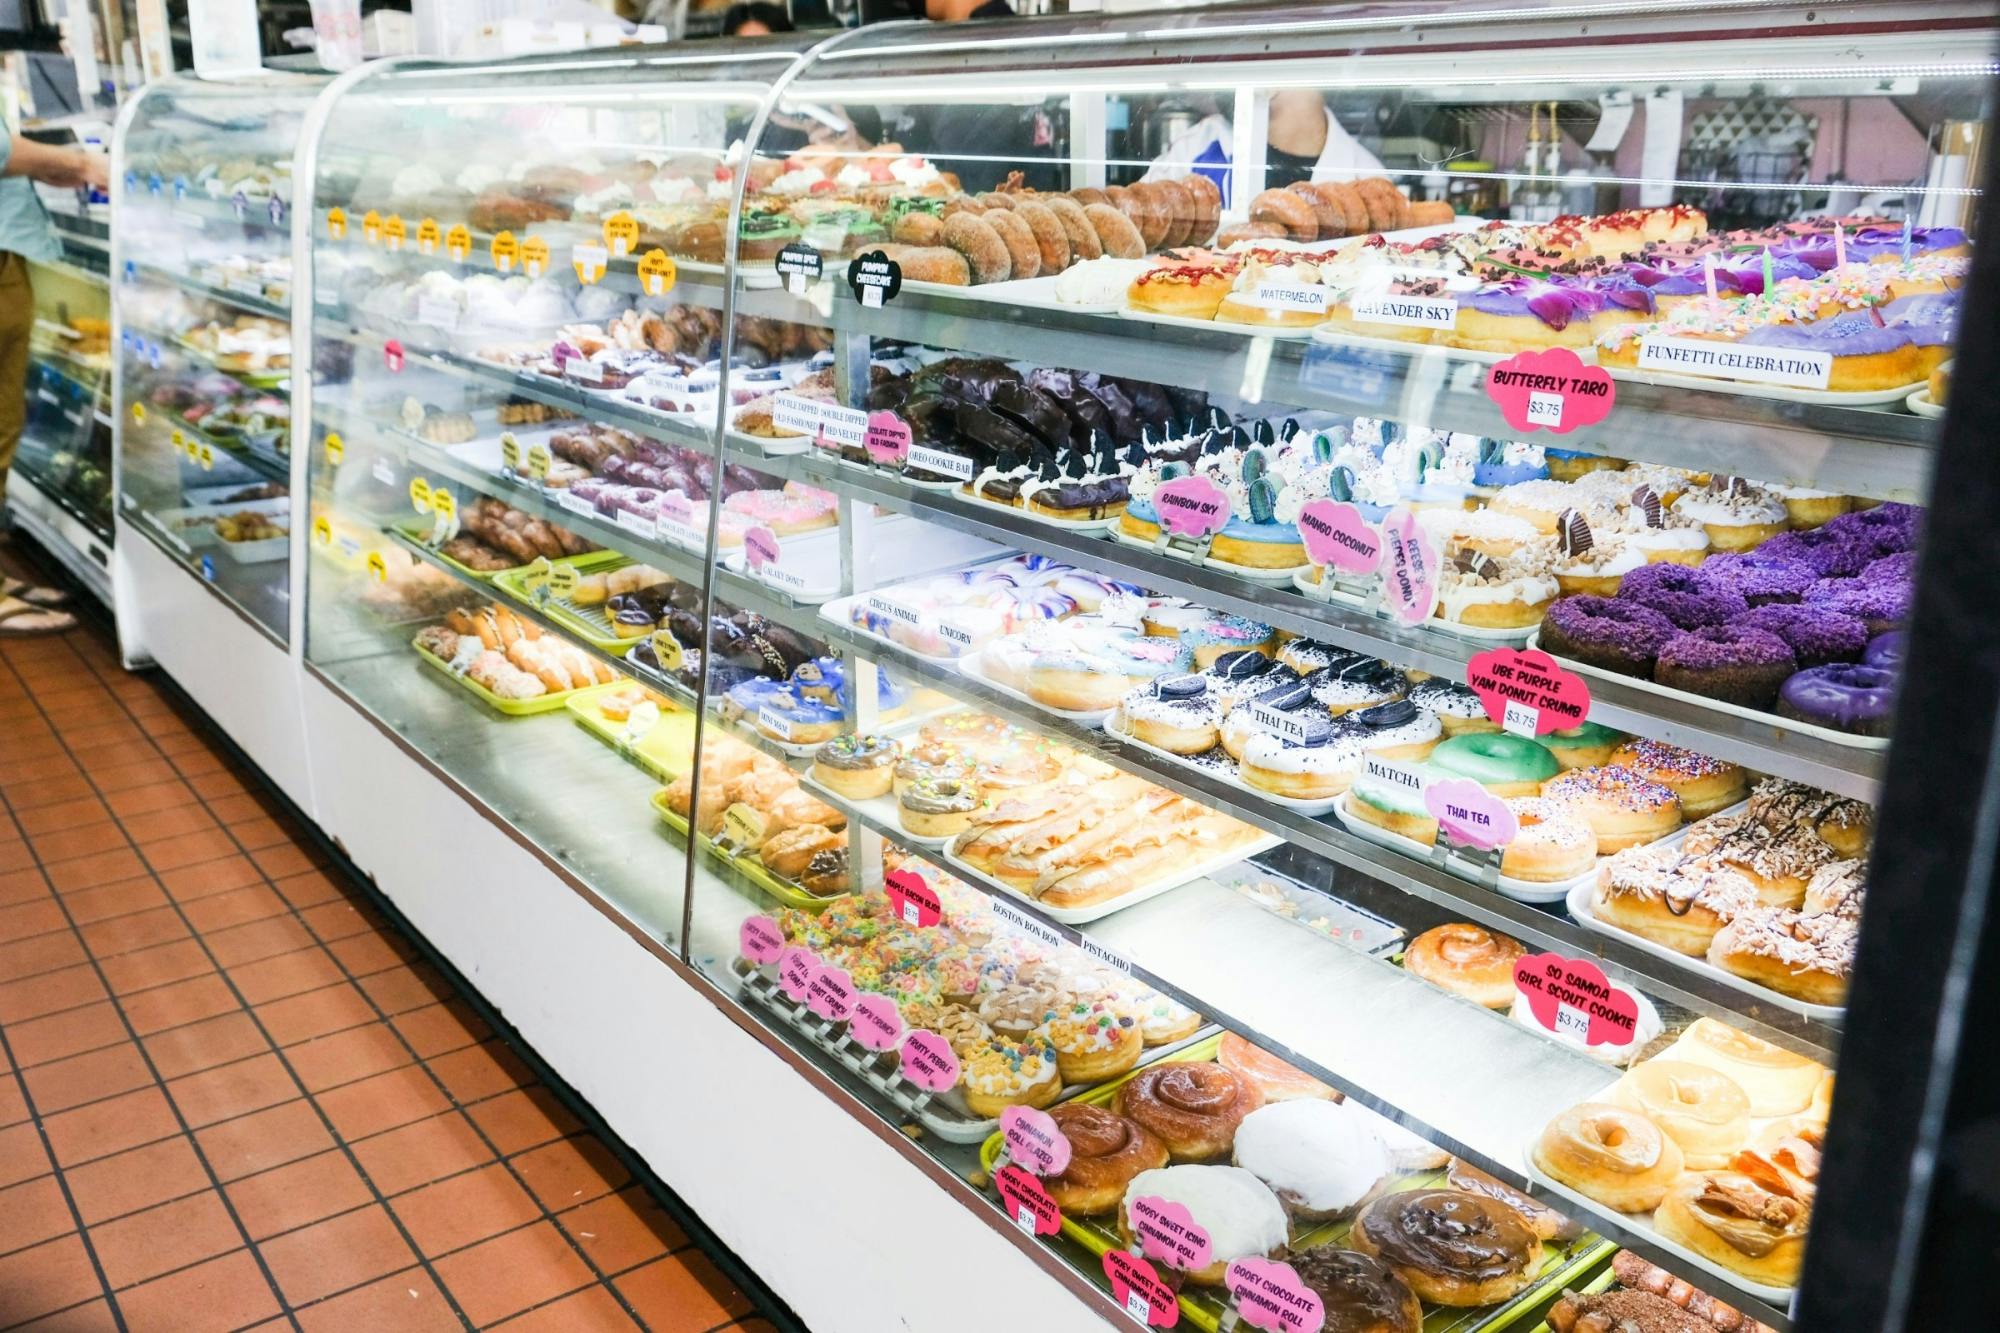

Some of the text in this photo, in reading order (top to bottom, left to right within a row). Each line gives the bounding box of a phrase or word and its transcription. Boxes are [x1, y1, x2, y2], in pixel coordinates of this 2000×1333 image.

[856, 261, 892, 286] PUMPKIN CHEESECAKE
[1260, 289, 1324, 304] WATERMELON
[1358, 301, 1454, 321] LAVENDER SKY
[1646, 346, 1823, 377] FUNFETTI CELEBRATION
[1494, 370, 1608, 397] BUTTERFLY TARO
[777, 398, 819, 415] DOUBLE DIPPED
[820, 408, 866, 426] DOUBLE DIPPED
[1528, 400, 1560, 417] $3.75
[787, 416, 818, 431] FASHIONED
[909, 450, 970, 474] OREO COOKIE BAR
[1161, 493, 1218, 516] RAINBOW SKY
[1302, 512, 1376, 558] MANGO COCONUT
[1388, 528, 1416, 610] PIECES DONUT
[869, 598, 919, 624] CIRCUS ANIMAL
[939, 625, 972, 645] UNICORN
[1492, 662, 1562, 693] UBE PURPLE
[1472, 674, 1582, 718] YAM DONUT CRUMB
[1254, 709, 1304, 738] THAI TEA
[1506, 709, 1535, 728] $3.75
[1368, 761, 1420, 790] MATCHA
[1446, 805, 1490, 827] THAI TEA
[886, 878, 904, 894] MAPLE
[905, 888, 924, 904] BACON
[993, 902, 1060, 947] BOSTON BON BON
[1083, 940, 1129, 972] PISTACHIO
[788, 970, 805, 989] DONUT
[820, 975, 848, 999] CINNAMON
[1545, 964, 1610, 1001] SO SAMOA
[809, 982, 848, 1015] TOAST CRUNCH
[1518, 970, 1636, 1030] GIRL SCOUT COOKIE
[872, 1016, 896, 1036] CRUNCH
[1557, 1012, 1587, 1033] $3.75
[908, 1036, 952, 1073] FRUITY PEBBLE
[912, 1057, 934, 1076] DONUT
[1007, 1128, 1054, 1165] ROLL GLAZED
[1016, 1117, 1054, 1149] CINNAMON
[1001, 1170, 1057, 1213] GOOEY CHOCOLATE
[1005, 1184, 1053, 1224] CINNAMON ROLL
[1136, 1201, 1206, 1248] GOOEY SWEET ICING
[1138, 1220, 1196, 1261] CINNAMON ROLL
[1109, 1253, 1175, 1305] GOOEY SWEET ICING
[1114, 1270, 1167, 1314] CINNAMON ROLL
[1234, 1265, 1315, 1313] GOOEY CHOCOLATE
[1129, 1296, 1147, 1316] $3.75
[1235, 1284, 1304, 1327] CINNAMON ROLL
